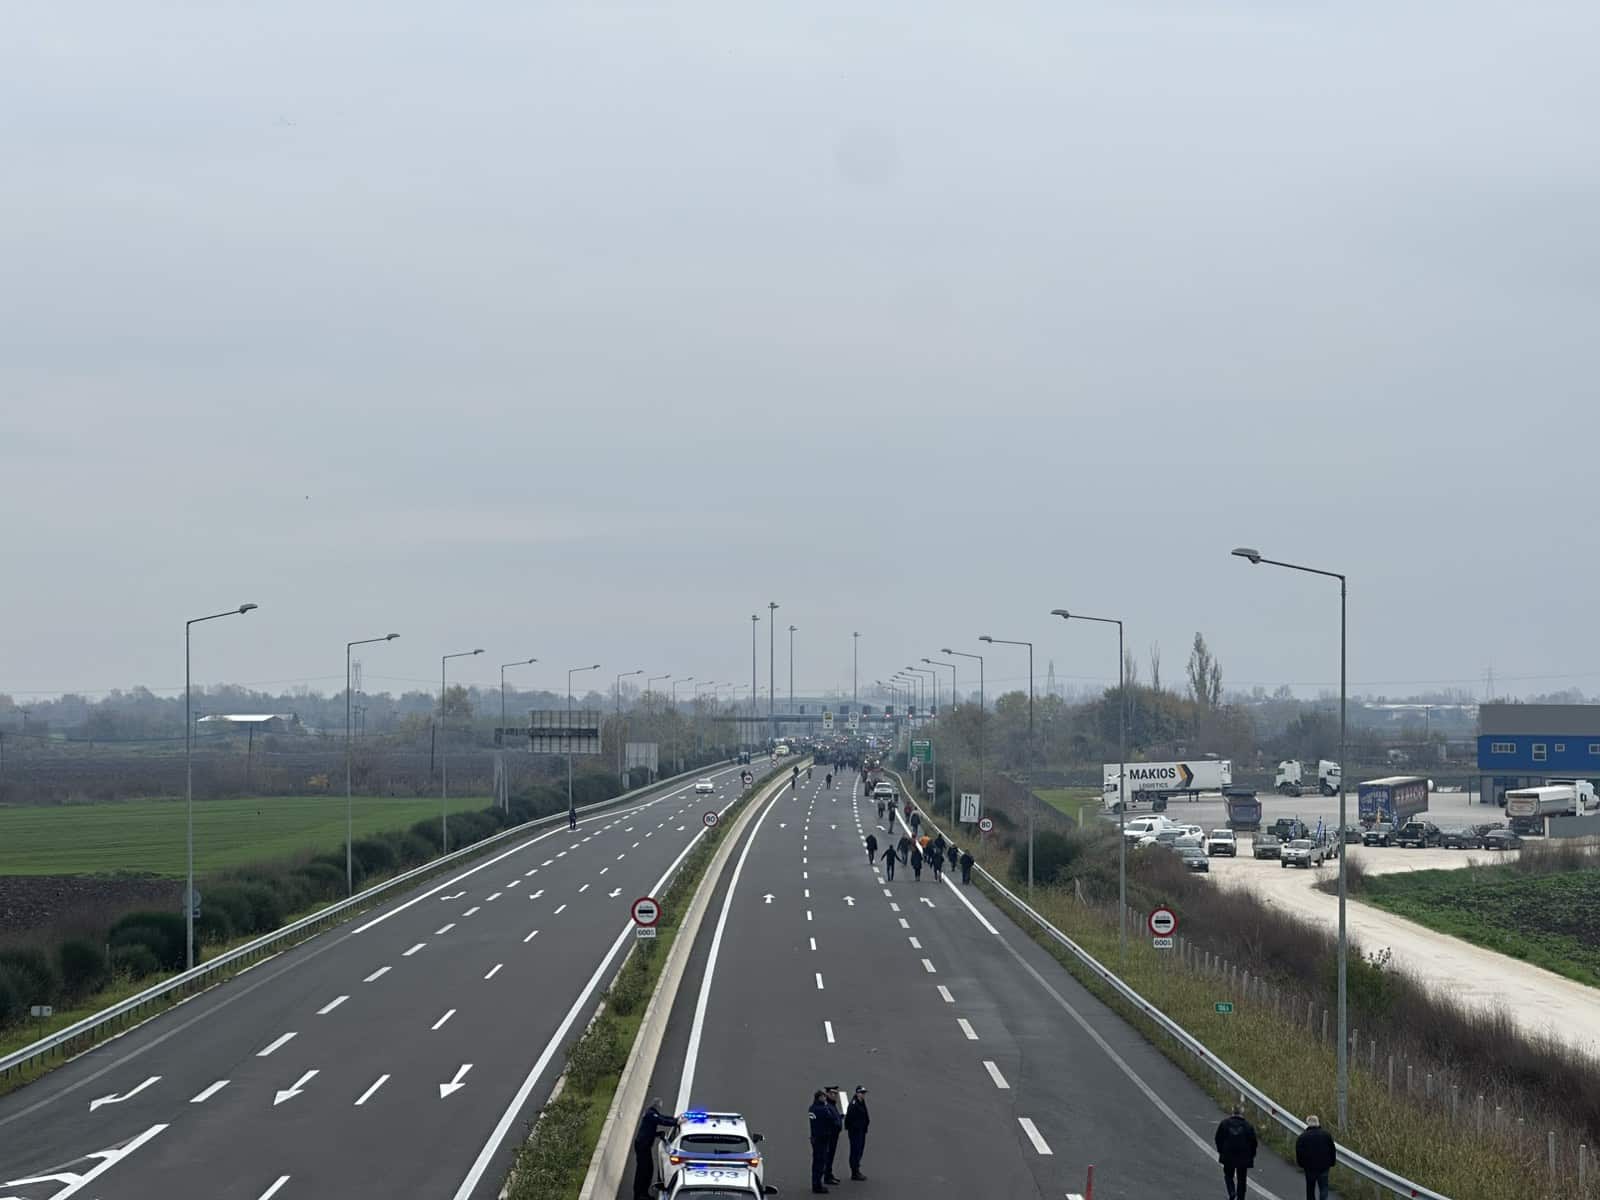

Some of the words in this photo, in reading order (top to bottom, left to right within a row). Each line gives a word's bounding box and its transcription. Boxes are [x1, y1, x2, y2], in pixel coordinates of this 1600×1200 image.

[1129, 767, 1176, 780] MAKIOS
[1139, 782, 1169, 790] LOGISTICS
[694, 1170, 739, 1179] 303
